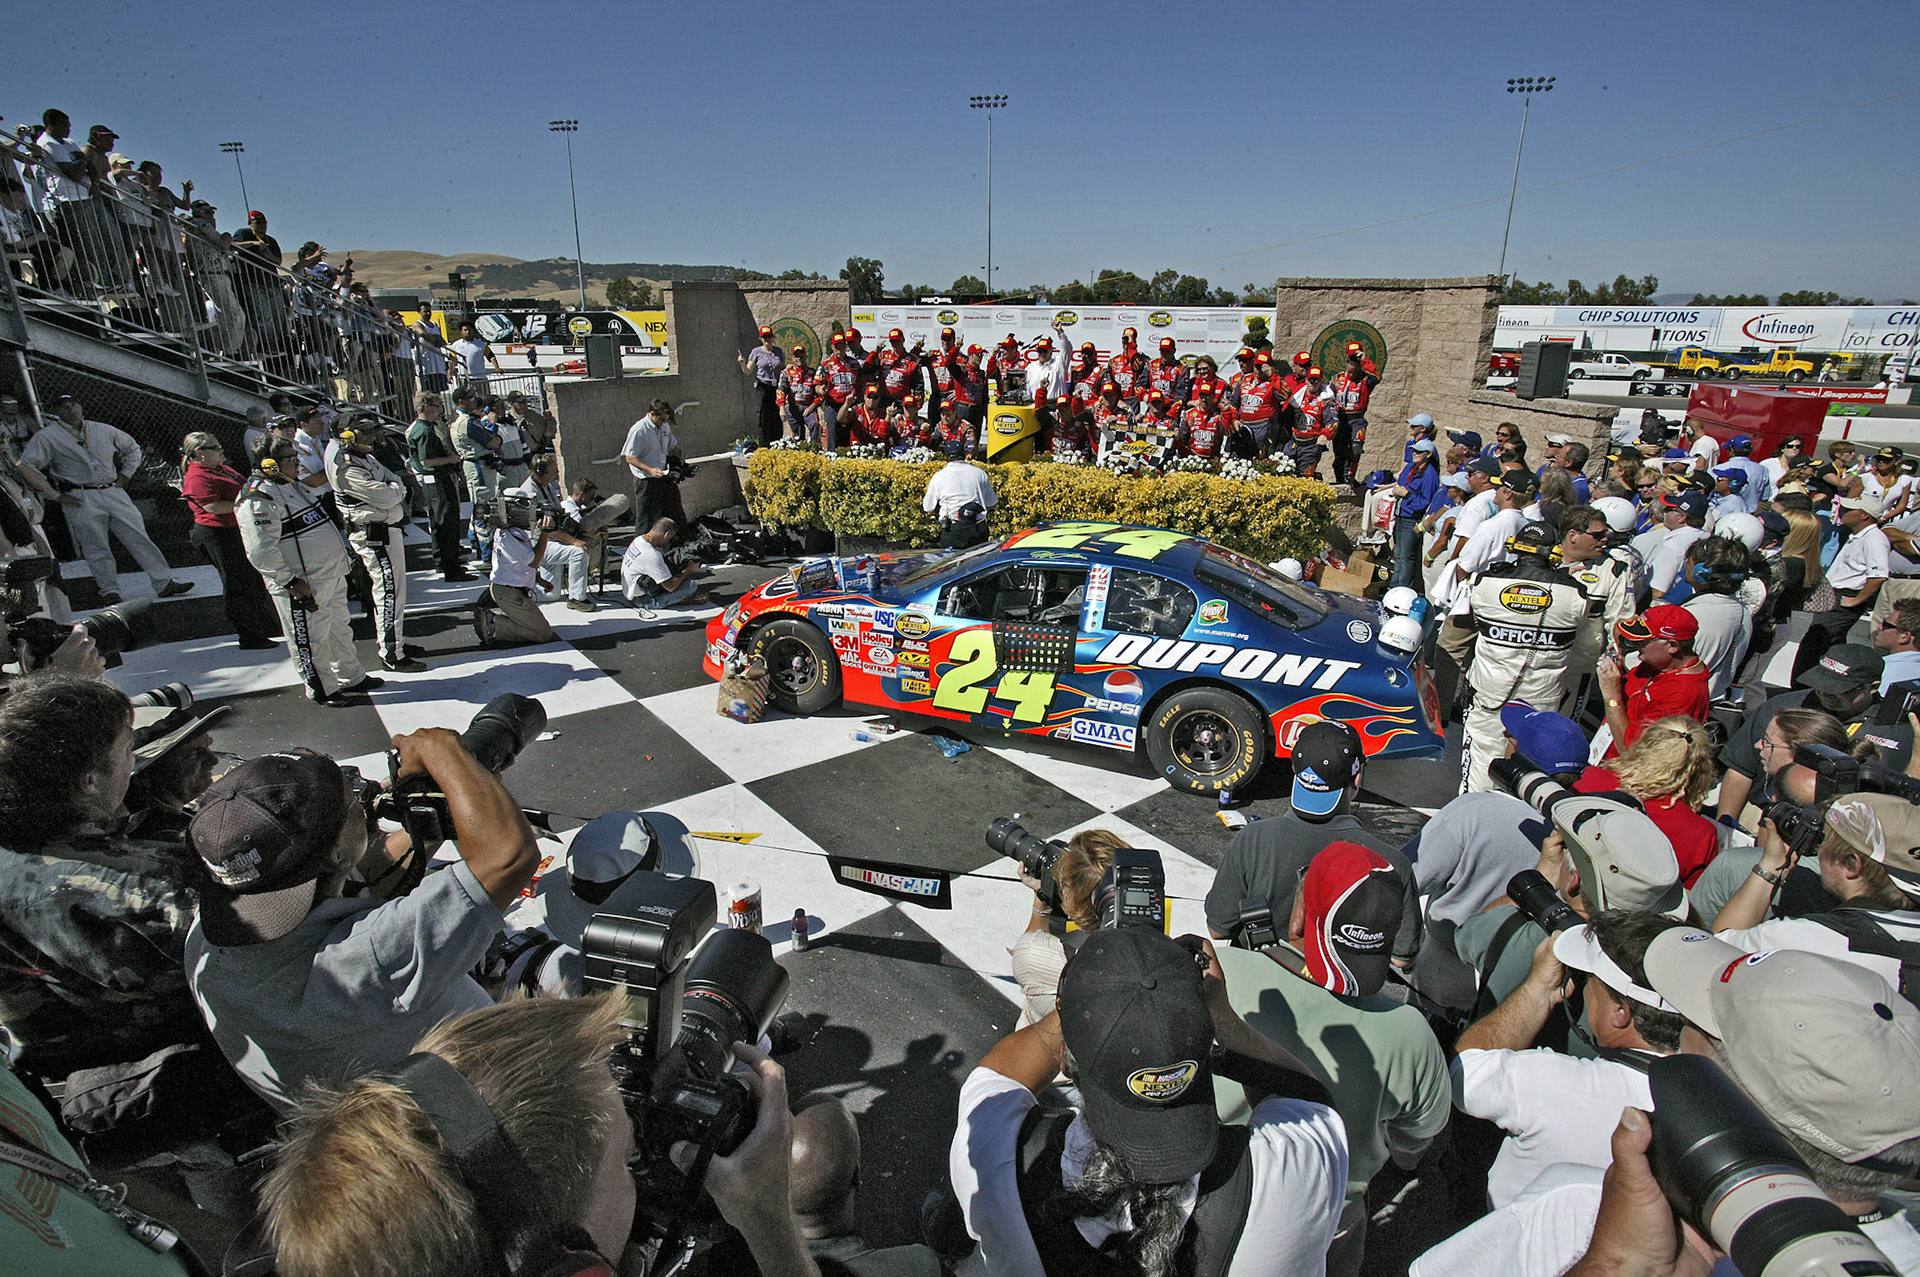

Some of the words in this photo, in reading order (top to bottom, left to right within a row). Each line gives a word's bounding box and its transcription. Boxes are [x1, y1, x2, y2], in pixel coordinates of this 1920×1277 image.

[525, 315, 547, 331] 12
[1579, 310, 1611, 322] CHIP
[1613, 311, 1700, 324] SOLUTIONS
[1757, 314, 1814, 334] Infineon
[645, 322, 667, 332] NEX
[1662, 330, 1709, 343] TIONS
[1845, 332, 1874, 349] for
[1822, 390, 1861, 399] Snap-on
[1862, 391, 1887, 399] Tools
[380, 557, 393, 591] NASCAR
[846, 577, 868, 588] PEP
[1509, 595, 1542, 605] NEXTEL
[384, 593, 395, 628] OFFICIAL
[759, 603, 807, 617] GOODYEAR
[293, 609, 307, 644] NASCAR
[875, 611, 894, 628] USG
[863, 632, 893, 647] Holley
[1193, 627, 1250, 641] www.marrow.org
[1489, 626, 1557, 646] OFFICIAL
[834, 635, 859, 651] 3M
[903, 639, 928, 648] BUD
[874, 649, 889, 659] EA
[1096, 633, 1362, 691] DUPONT
[863, 664, 896, 674] OUTBACK
[932, 628, 1056, 724] 24
[1083, 696, 1141, 716] PEPSI
[1159, 705, 1182, 729] EAGLE
[1074, 720, 1134, 743] GMAC
[1301, 772, 1319, 783] GP
[870, 873, 935, 896] NASCAR
[729, 911, 760, 929] Viva
[1347, 924, 1385, 941] Infineon
[1157, 1067, 1187, 1083] NASCAR
[1143, 1078, 1186, 1090] NEXTEL
[1803, 1119, 1852, 1156] NASCAR
